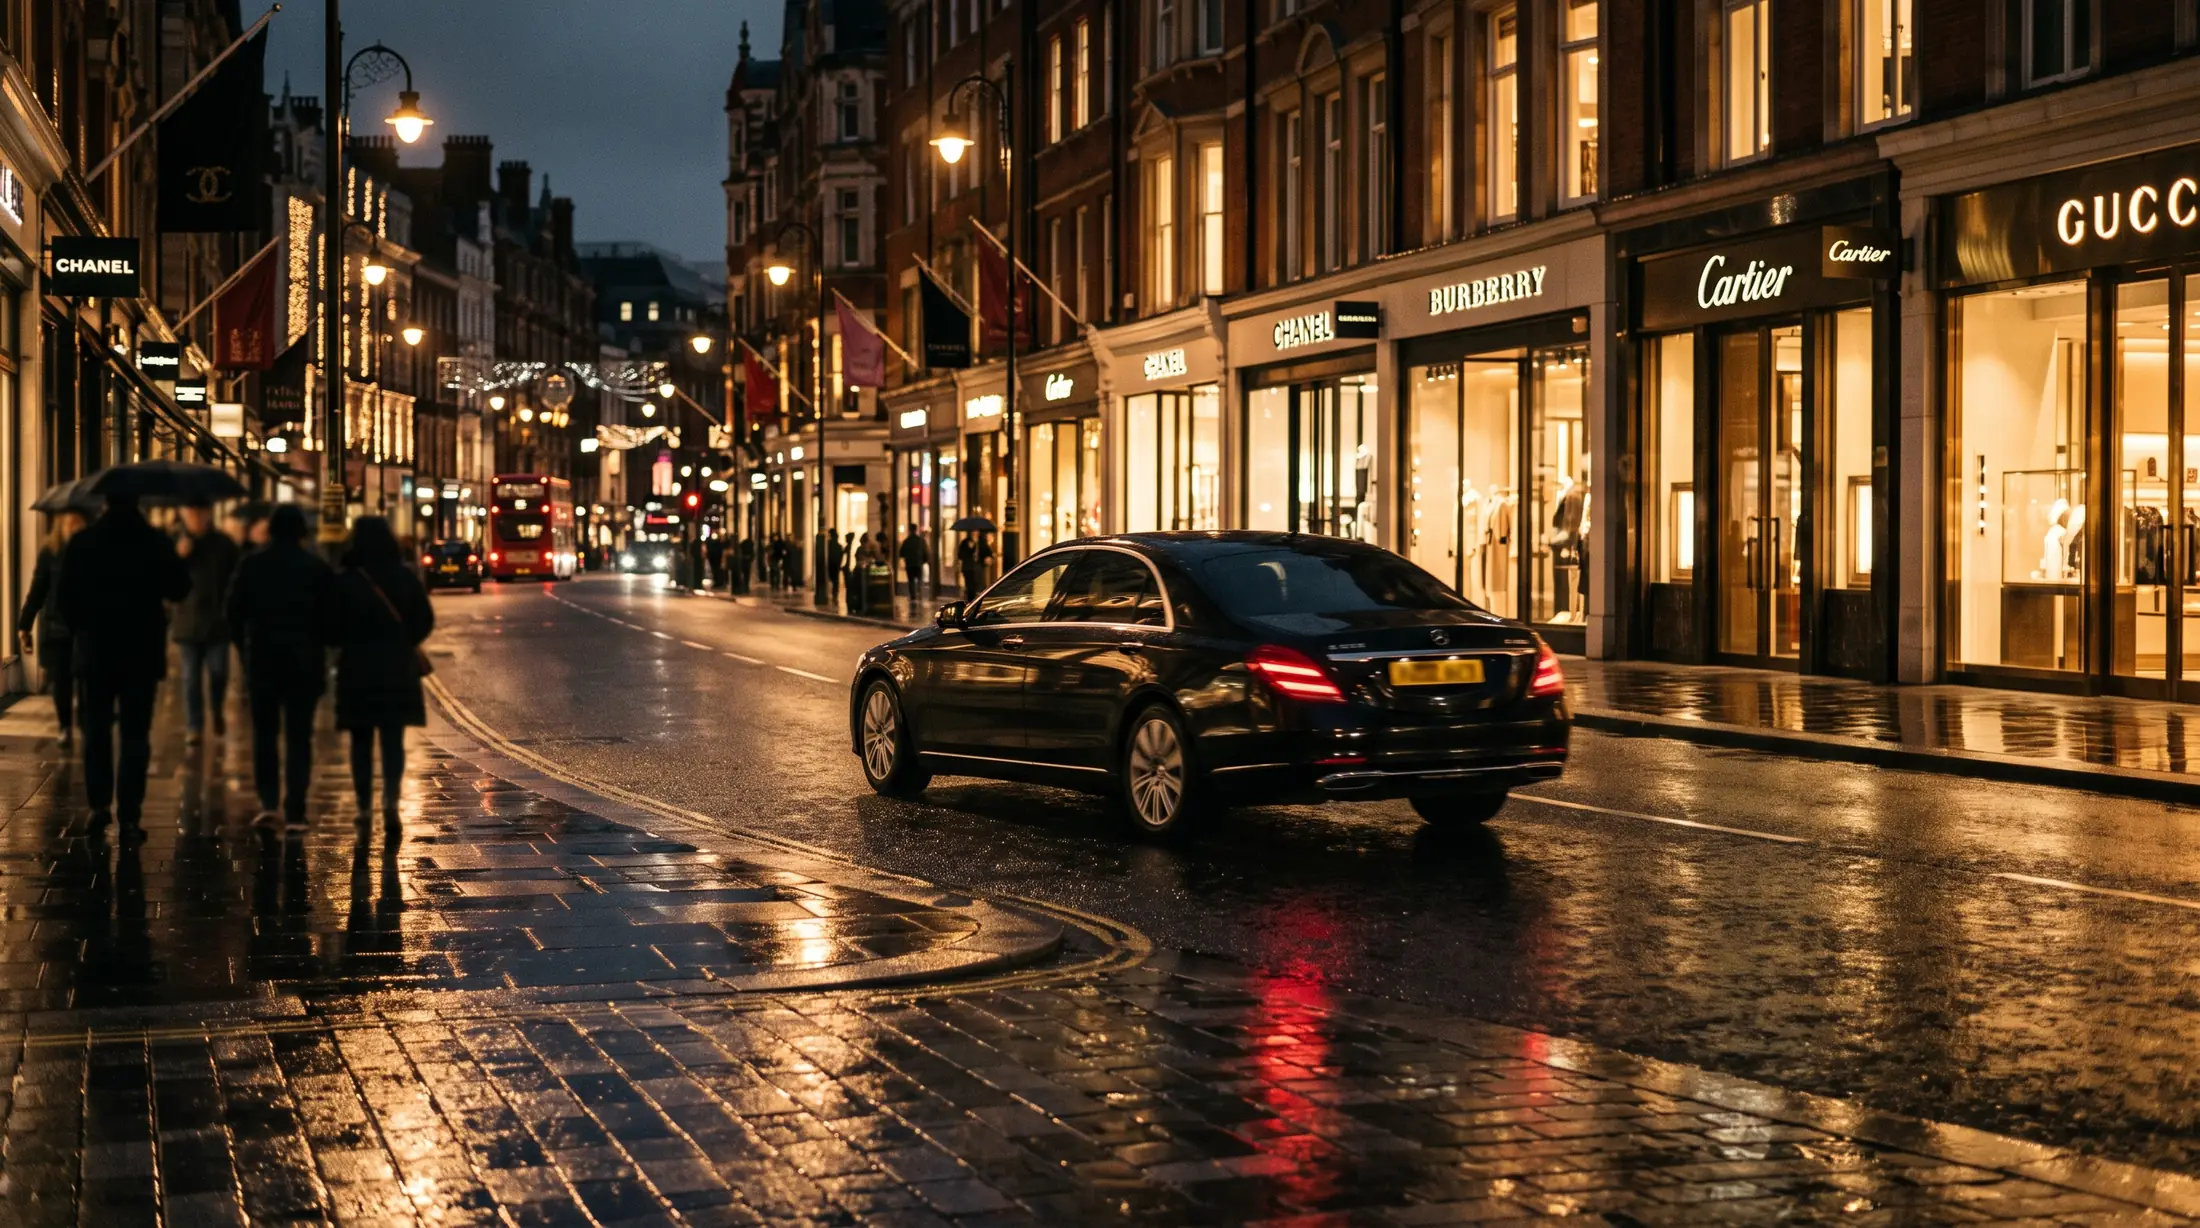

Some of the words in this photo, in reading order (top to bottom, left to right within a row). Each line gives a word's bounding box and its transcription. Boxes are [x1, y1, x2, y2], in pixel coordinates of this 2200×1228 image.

[2057, 177, 2198, 246] GUCC
[55, 258, 134, 274] CHANEL
[1829, 240, 1891, 262] Cartier
[1429, 265, 1547, 316] BURBERRY
[1698, 254, 1793, 309] Cartier
[1273, 309, 1334, 351] CHANEL
